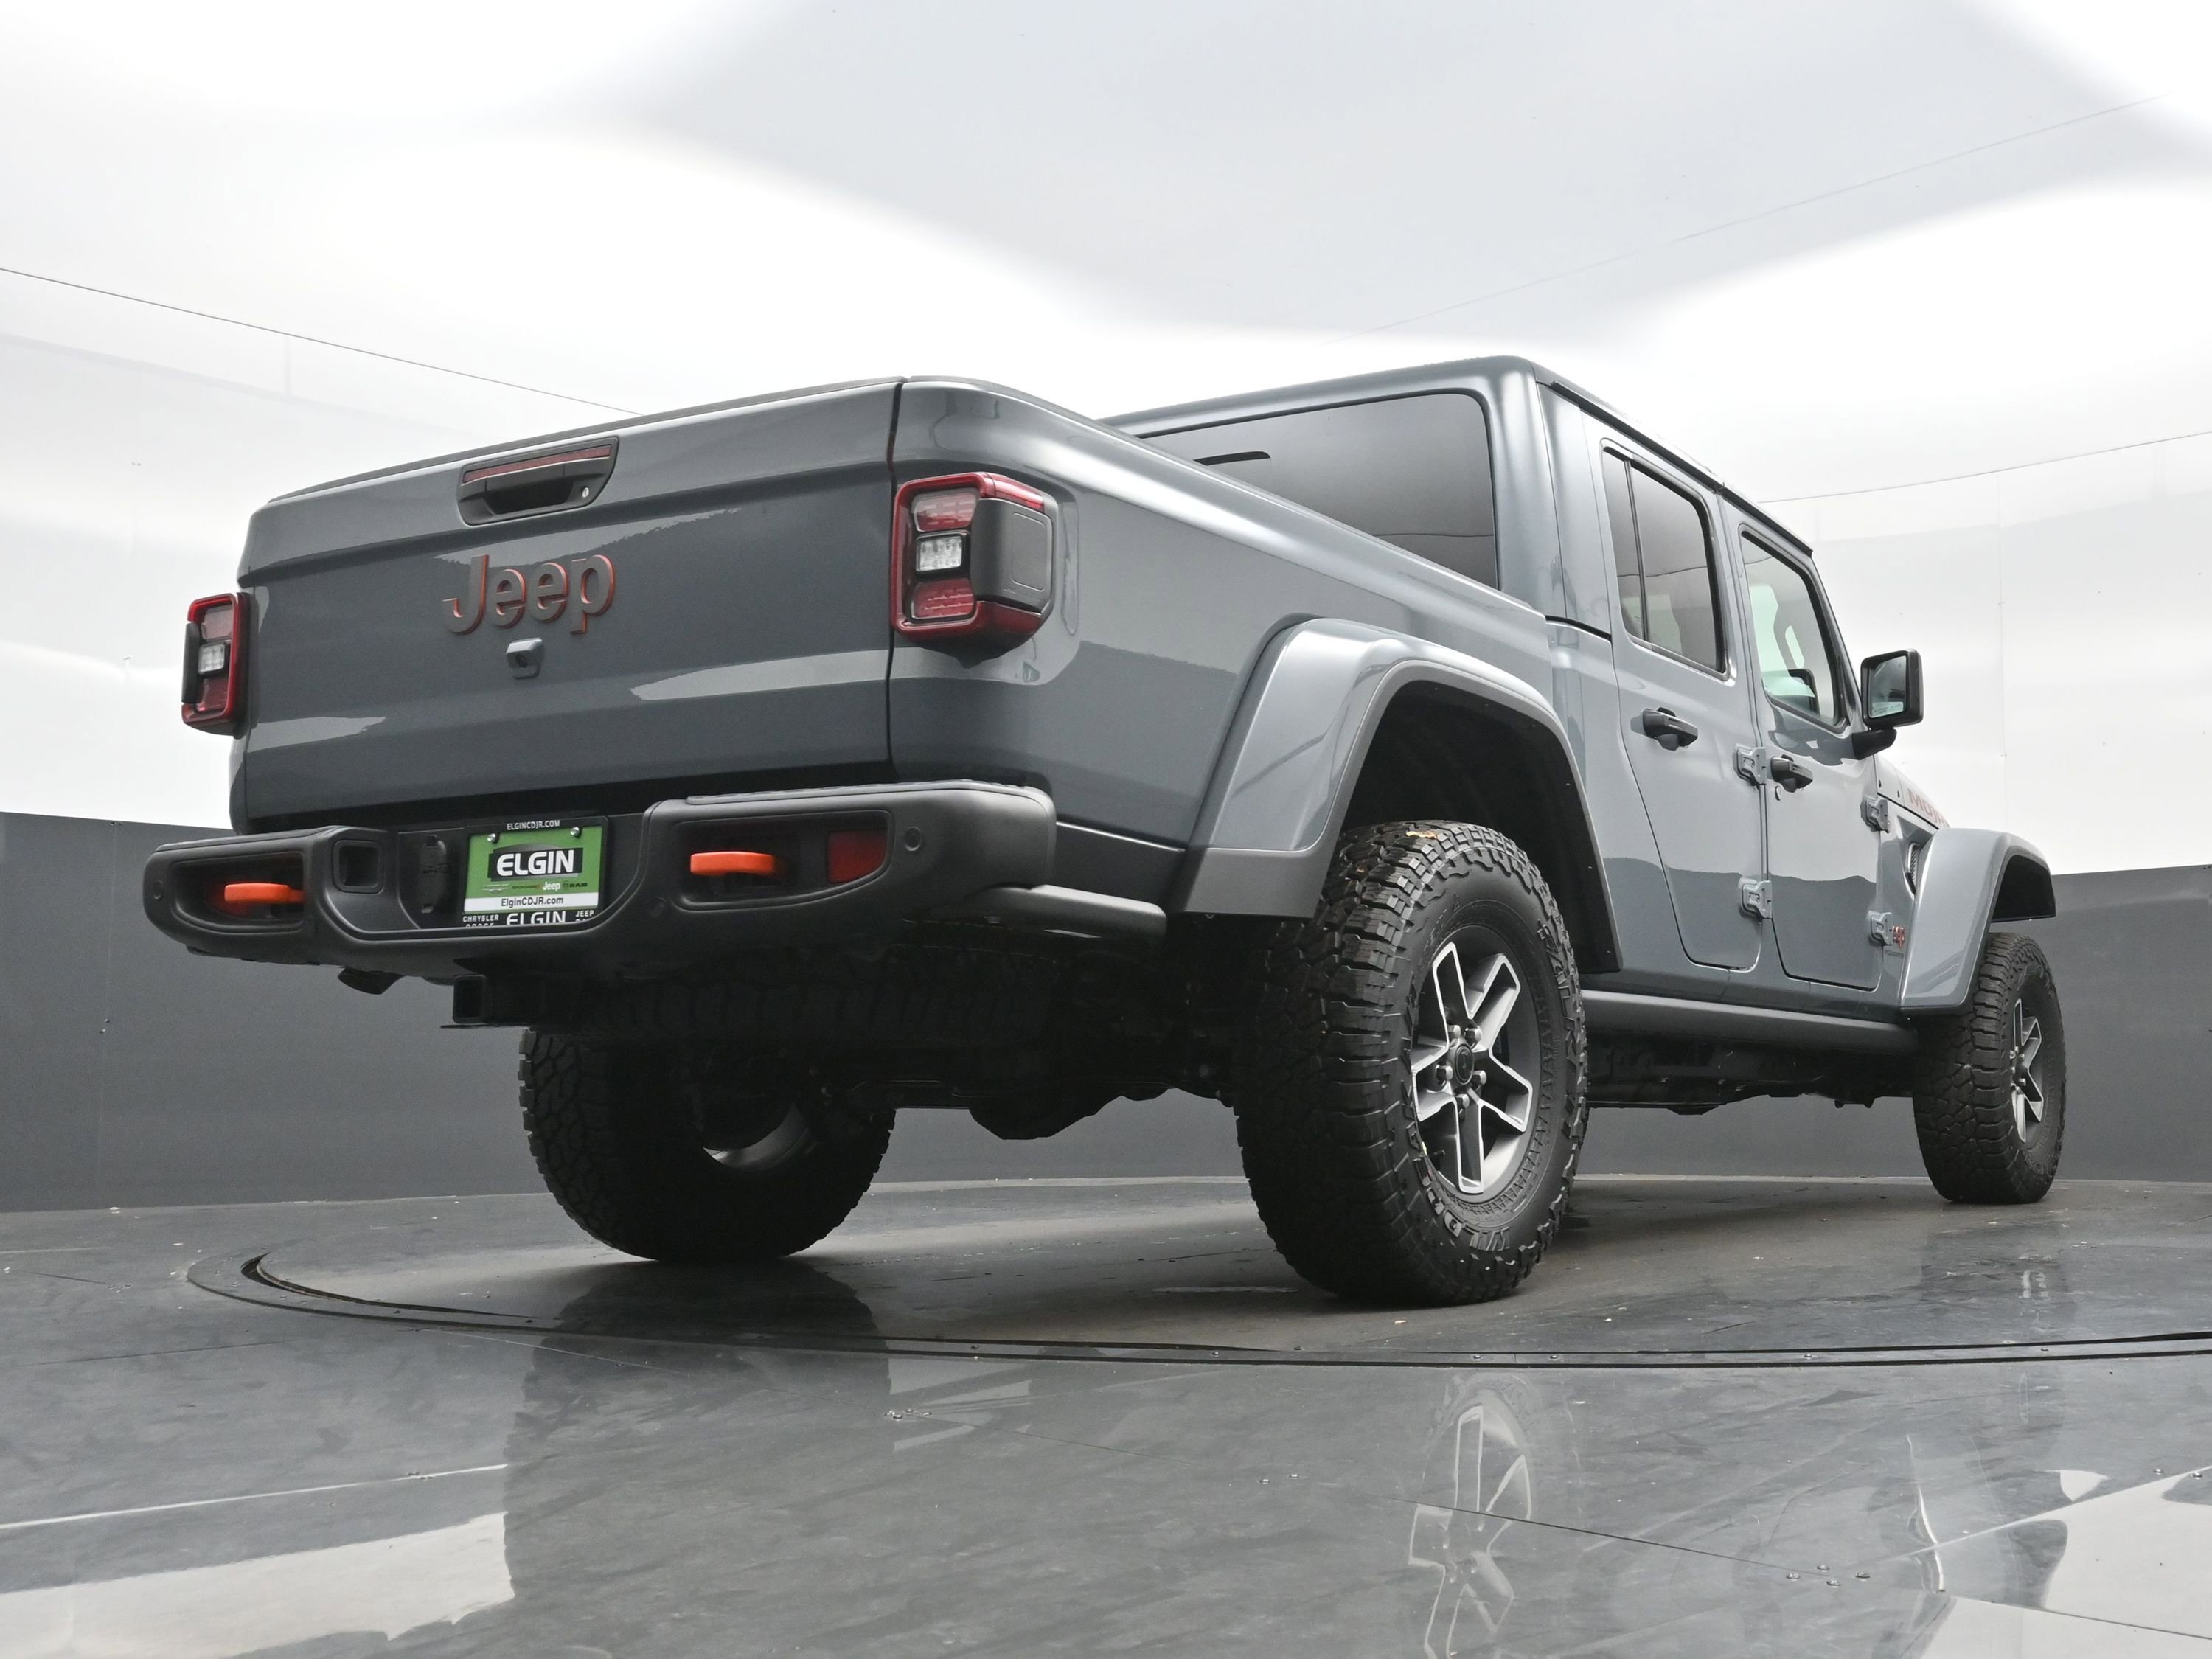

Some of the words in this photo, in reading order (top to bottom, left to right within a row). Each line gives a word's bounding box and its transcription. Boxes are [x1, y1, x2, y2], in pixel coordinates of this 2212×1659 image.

[442, 554, 616, 636] Jeep
[507, 819, 560, 831] ELGINCDJR.COM
[496, 849, 575, 877] ELGIN
[542, 881, 561, 891] Jeep
[501, 896, 564, 908] ElginCDJR.com
[462, 914, 499, 922] CHRYSLER
[575, 909, 594, 917] JEEP
